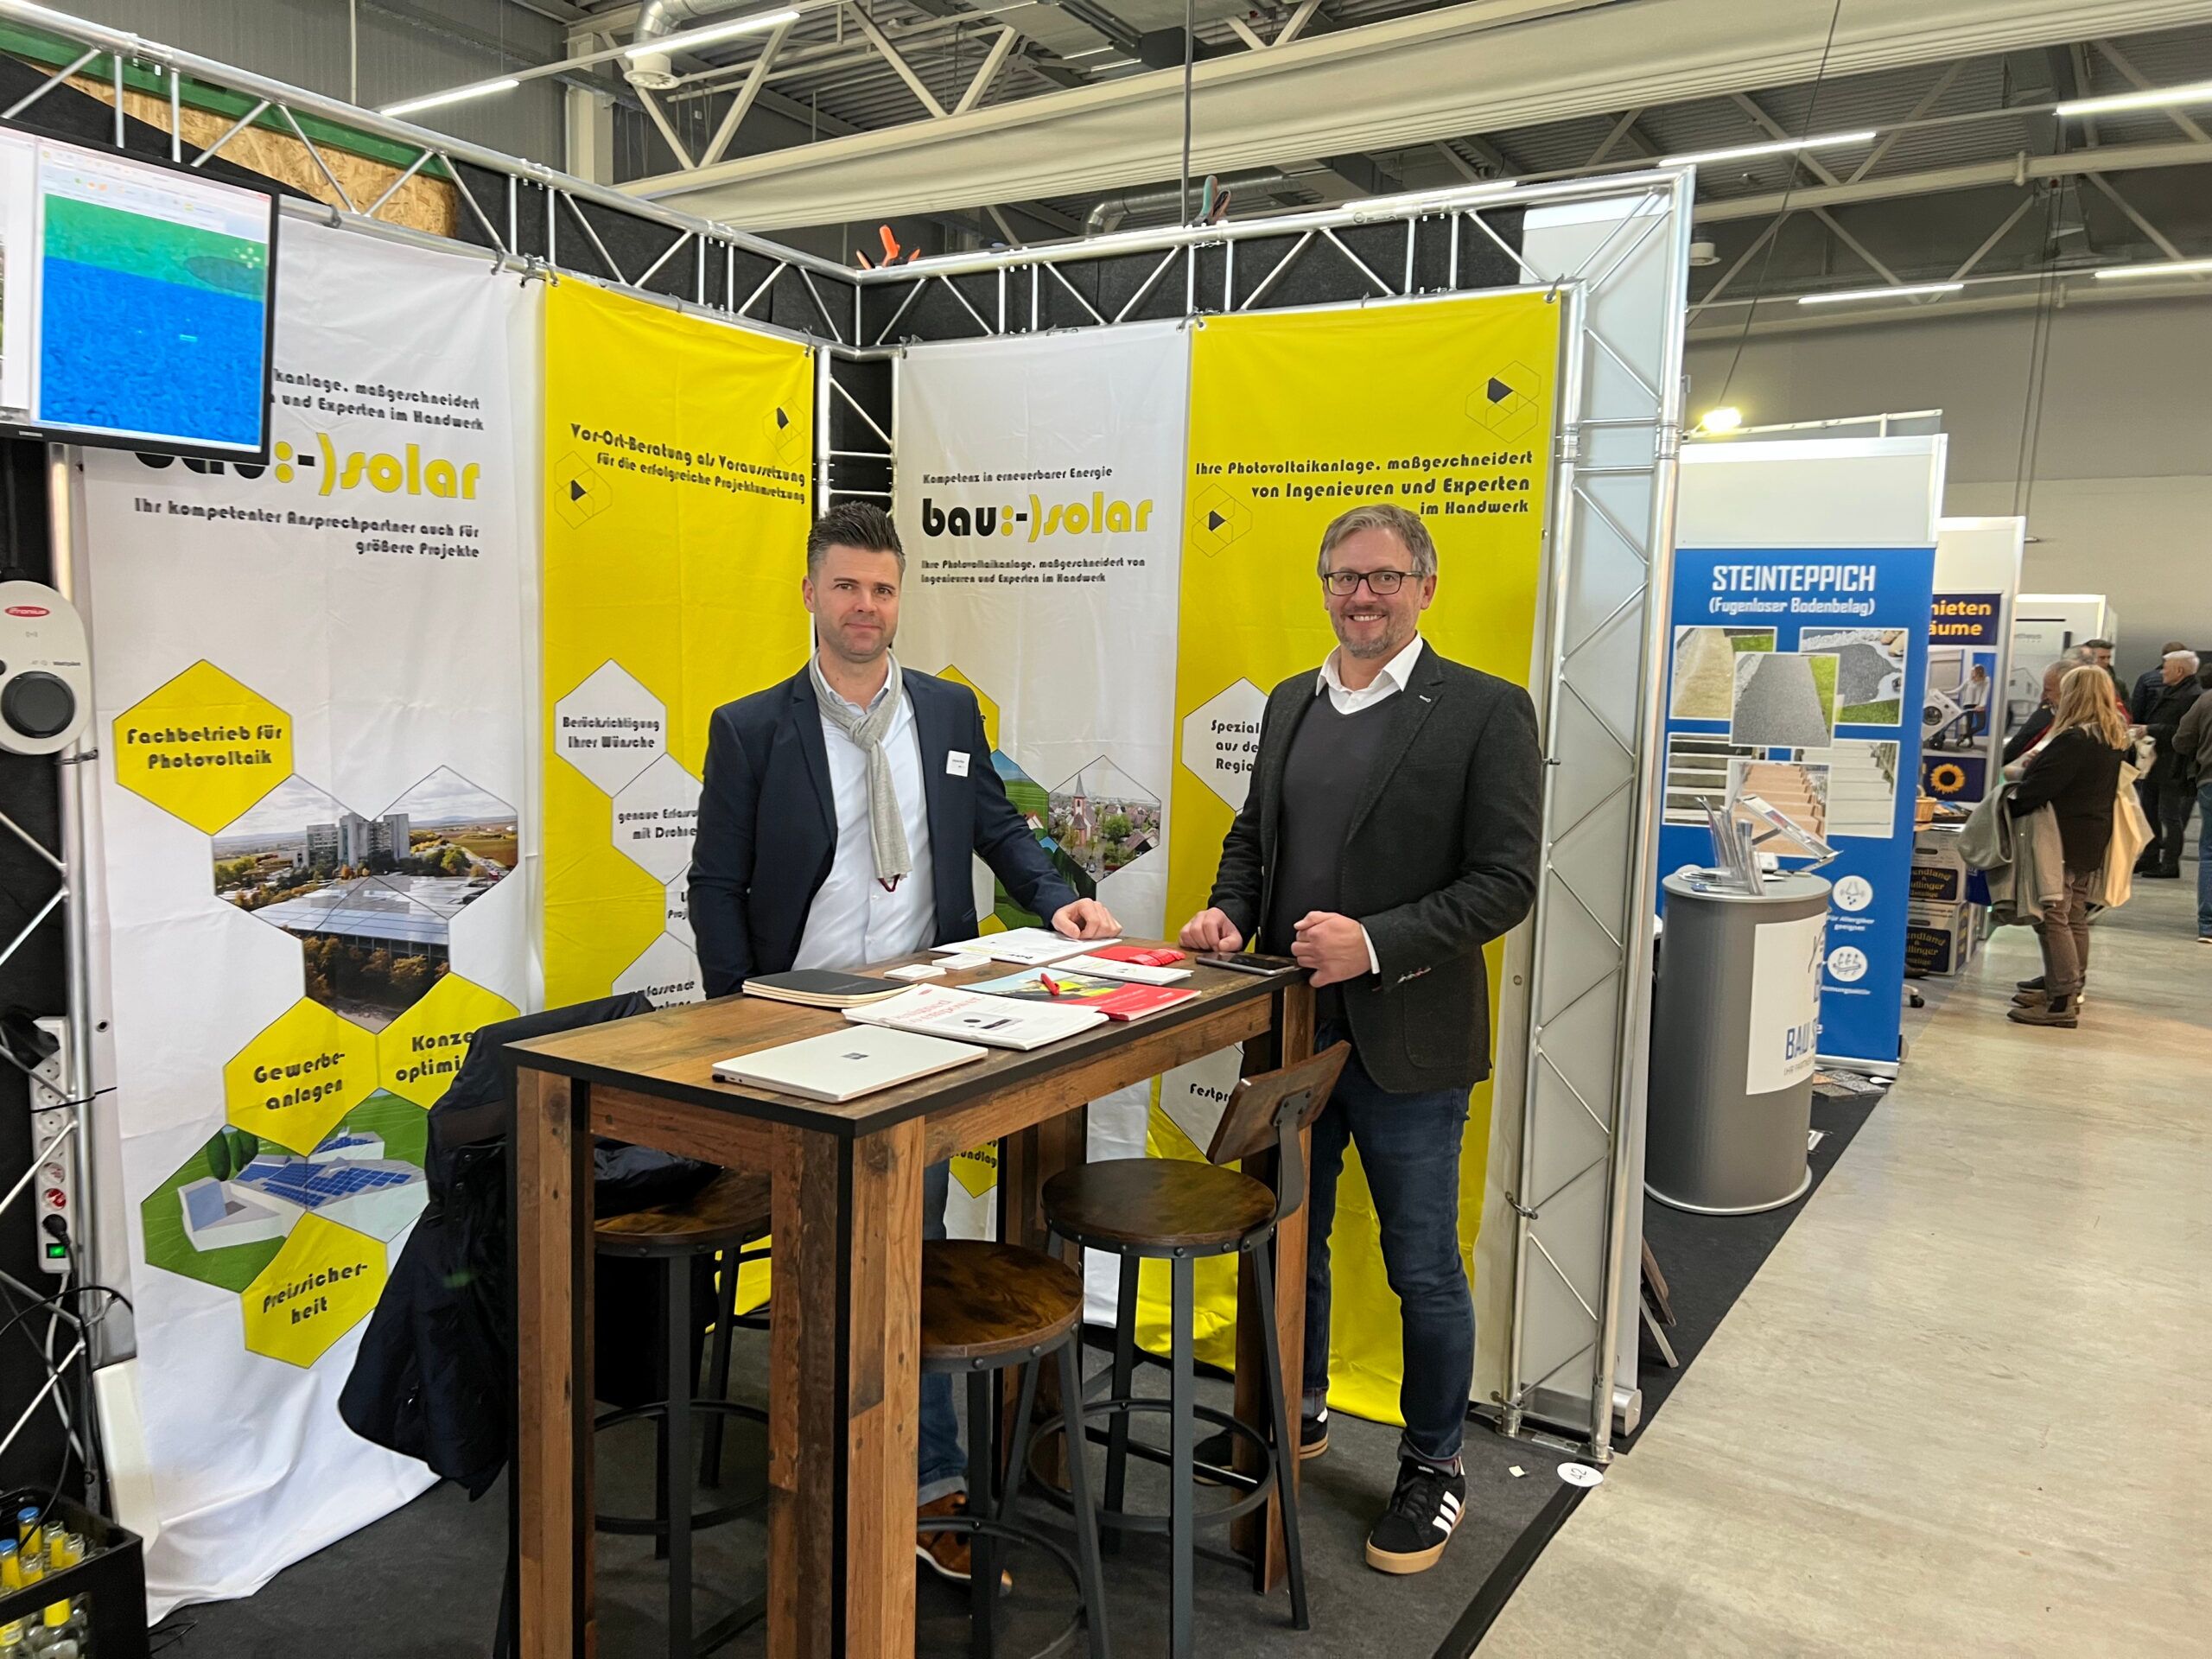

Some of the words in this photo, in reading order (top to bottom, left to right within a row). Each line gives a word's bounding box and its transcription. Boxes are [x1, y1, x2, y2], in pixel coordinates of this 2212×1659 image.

[355, 383, 480, 410] maßgeschneidert
[282, 393, 312, 408] und
[318, 397, 385, 416] Experten
[391, 407, 408, 422] im
[413, 410, 484, 430] Handwerk
[570, 423, 692, 466] Vor-Ort-Beratung
[697, 451, 715, 467] als
[719, 454, 805, 486] Voraussetzung
[1196, 461, 1223, 475] Ihre
[1387, 450, 1533, 473] maßgeschneidert
[596, 452, 615, 466] für
[618, 456, 636, 471] die
[640, 462, 711, 486] erfolgreiche
[923, 473, 980, 485] Kompetenz
[983, 472, 993, 482] in
[996, 468, 1067, 481] erneuerbarer
[1070, 466, 1113, 480] Energie
[1251, 484, 1280, 499] von
[1286, 480, 1394, 501] Ingenieuren
[1402, 478, 1436, 495] und
[1443, 475, 1530, 496] Experten
[135, 498, 162, 512] Ihr
[168, 500, 282, 524] kompetenter
[287, 511, 416, 535] Ansprechpartner
[420, 524, 454, 537] auch
[459, 524, 480, 538] für
[1420, 501, 1439, 516] im
[1445, 499, 1529, 516] Handwerk
[356, 539, 415, 556] größere
[419, 543, 480, 560] Projekte
[1039, 557, 1124, 570] maßgeschneidert
[921, 574, 976, 585] Ingenieuren
[978, 574, 995, 583] und
[998, 574, 1039, 585] Experten
[1042, 573, 1054, 582] im
[1057, 573, 1106, 582] Handwerk
[1712, 565, 1876, 592] STEINTEPPICH
[1708, 597, 1788, 615] (Fugenloser
[1790, 597, 1875, 616] Bodenbelag)
[563, 716, 660, 731] Berücksichtigung
[1211, 720, 1260, 734] Spezial
[127, 726, 251, 744] Fachbetrieb
[257, 725, 282, 740] für
[568, 735, 598, 747] Ihrer
[601, 735, 655, 748] Wünsche
[1216, 741, 1238, 752] aus
[148, 748, 272, 769] Photovoltaik
[618, 810, 658, 823] genaue
[632, 827, 651, 840] mit
[253, 1052, 346, 1084] Gewerbe-
[265, 1078, 343, 1110] anlagen
[1190, 1083, 1231, 1103] Festpr
[263, 1263, 368, 1313] Preissicher-
[291, 1296, 327, 1325] heit
